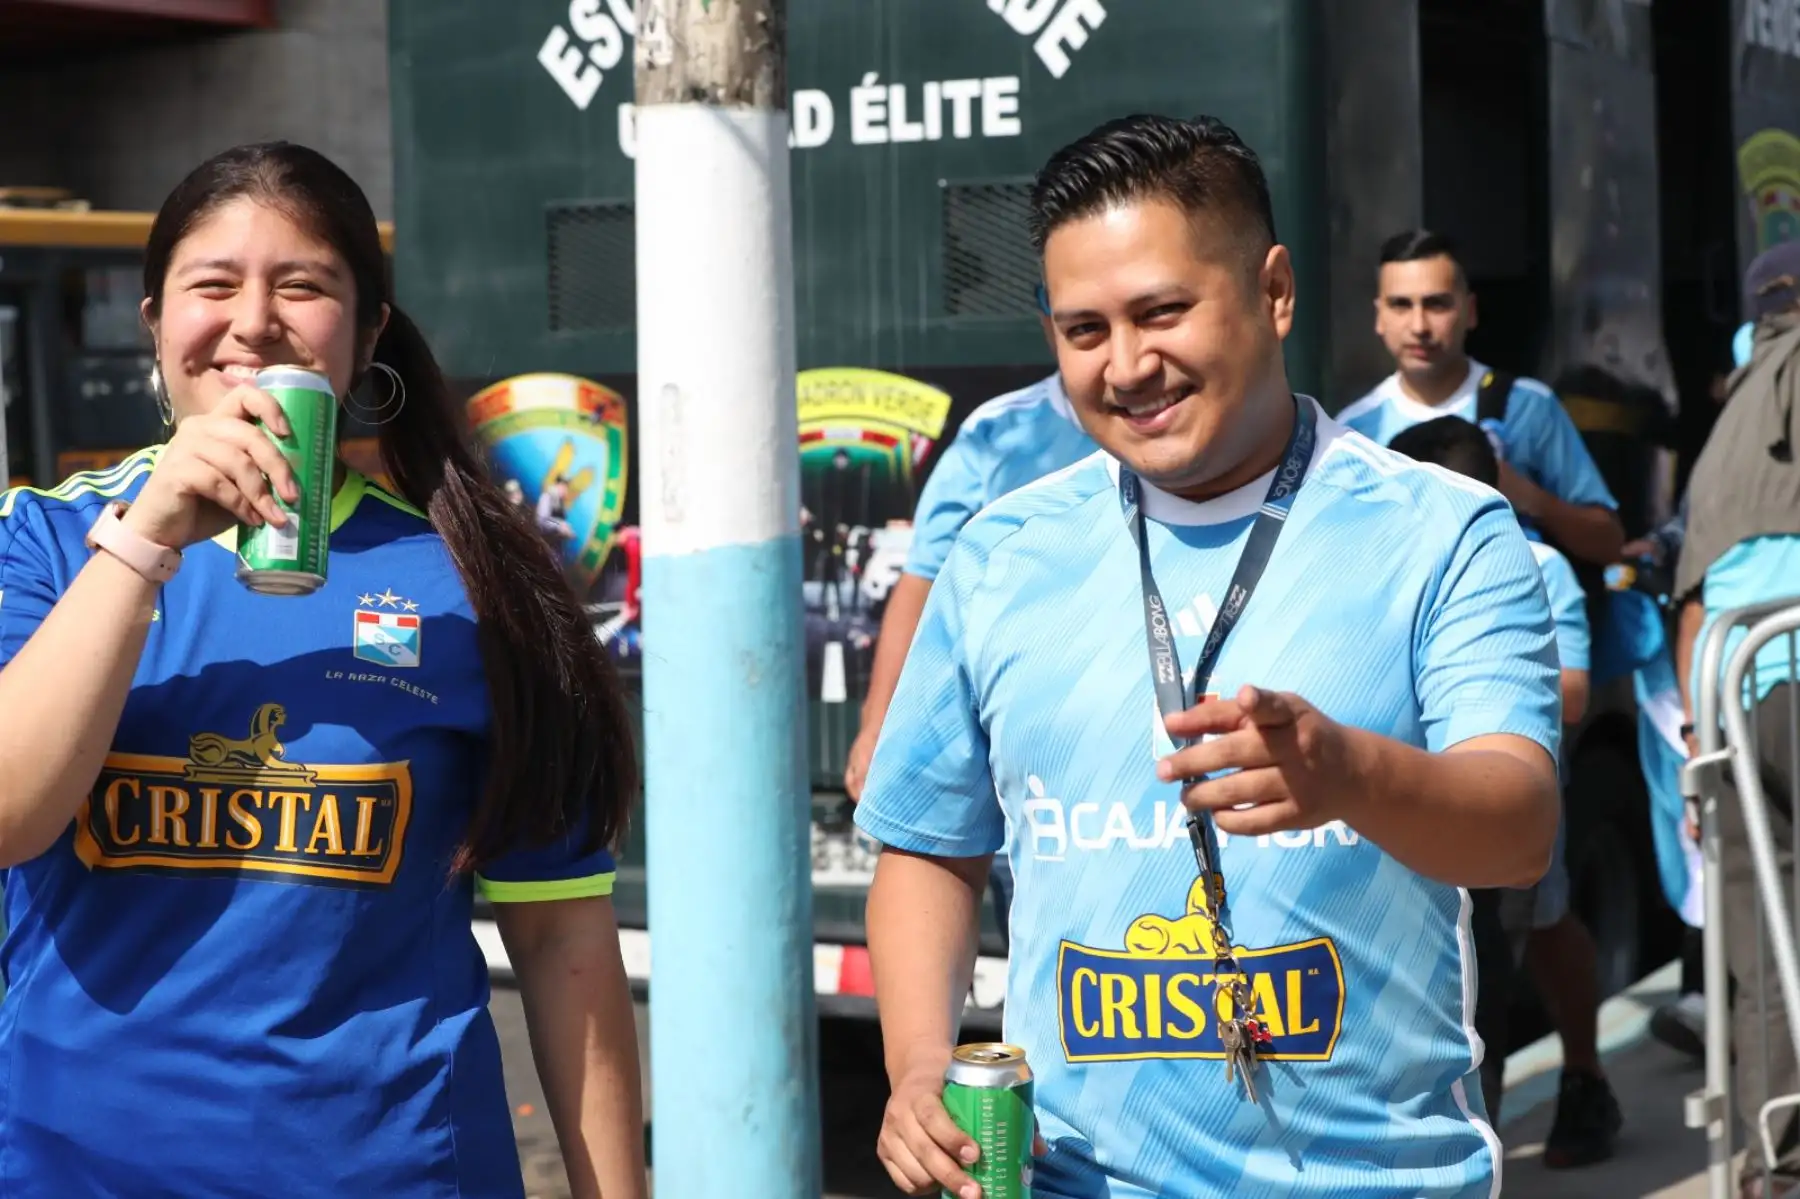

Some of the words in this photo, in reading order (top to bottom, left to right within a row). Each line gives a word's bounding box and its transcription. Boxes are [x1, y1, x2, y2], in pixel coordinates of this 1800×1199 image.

[850, 71, 1022, 145] ÉLITE
[1149, 594, 1173, 668] BILLABONG
[325, 669, 344, 679] LA
[390, 676, 439, 705] CELESTE
[104, 778, 385, 856] CRISTAL
[1071, 966, 1320, 1040] CRISTAL
